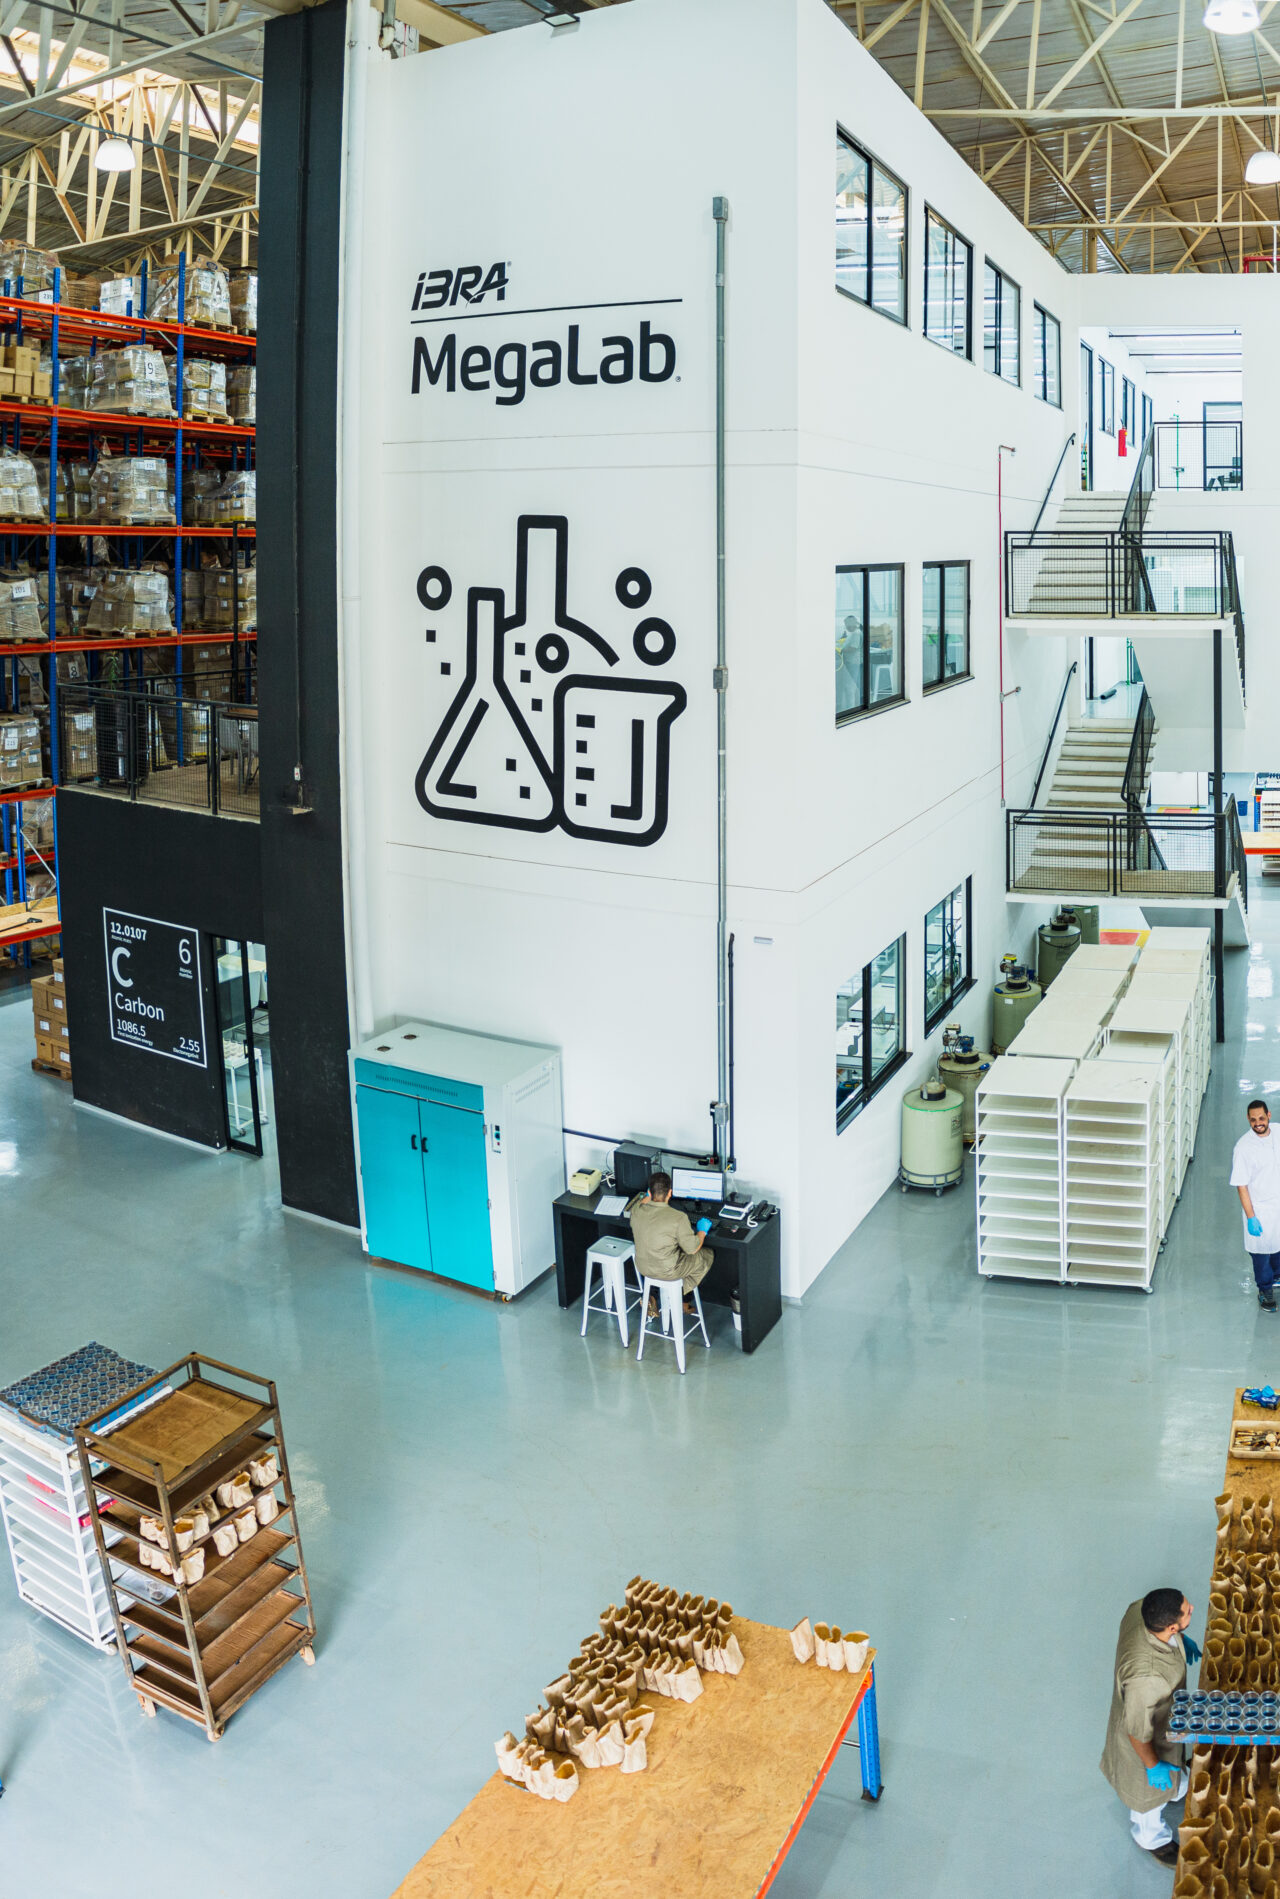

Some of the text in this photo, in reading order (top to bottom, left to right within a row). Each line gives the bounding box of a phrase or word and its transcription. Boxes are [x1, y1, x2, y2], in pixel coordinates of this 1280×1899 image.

[411, 320, 677, 406] MegaLab
[110, 921, 147, 941] 12.0107
[178, 938, 191, 965] 6
[111, 946, 134, 988] C
[115, 992, 165, 1021] Carbon
[116, 1018, 146, 1037] 1086.5
[179, 1036, 200, 1053] 2.55
